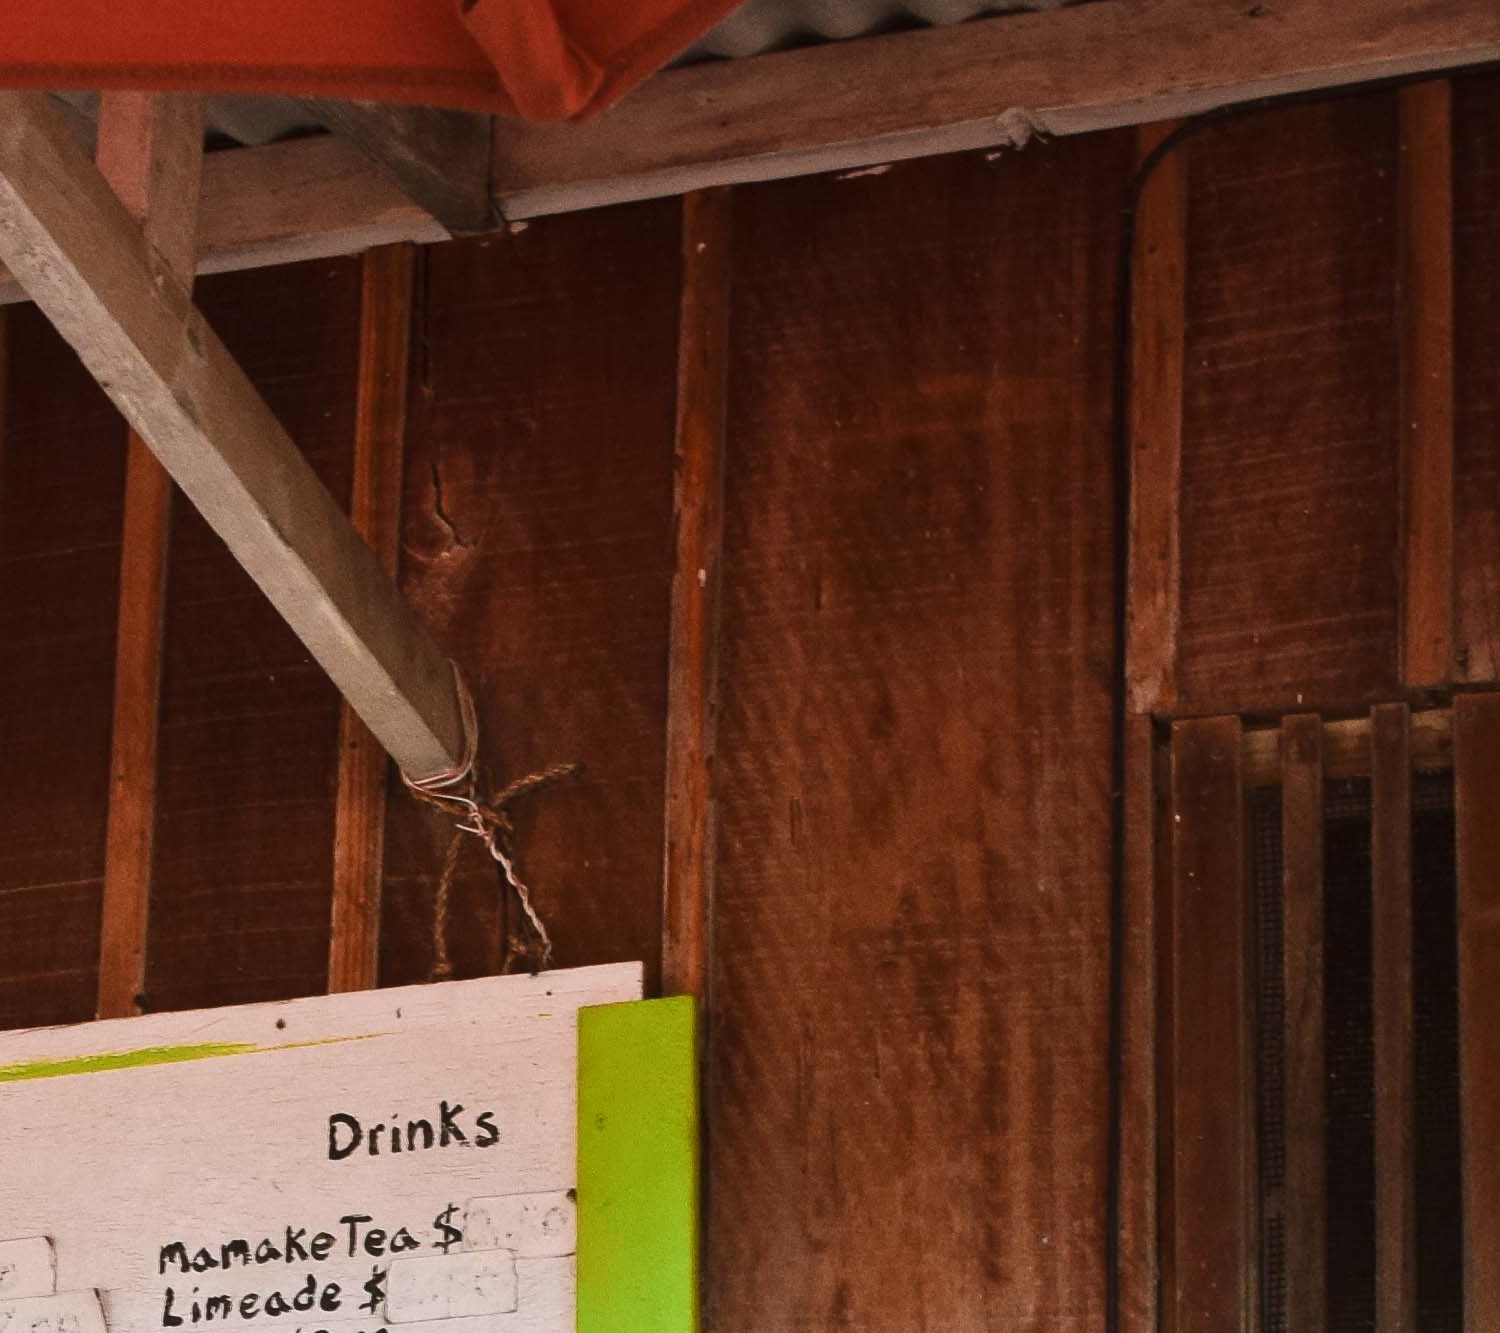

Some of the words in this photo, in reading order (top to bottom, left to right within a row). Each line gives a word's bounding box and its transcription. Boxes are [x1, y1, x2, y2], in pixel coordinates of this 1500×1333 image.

[328, 1100, 500, 1161] Drinks
[159, 1225, 338, 1275] Mamake
[339, 1214, 421, 1258] Tea
[162, 1273, 342, 1328] Limeade
